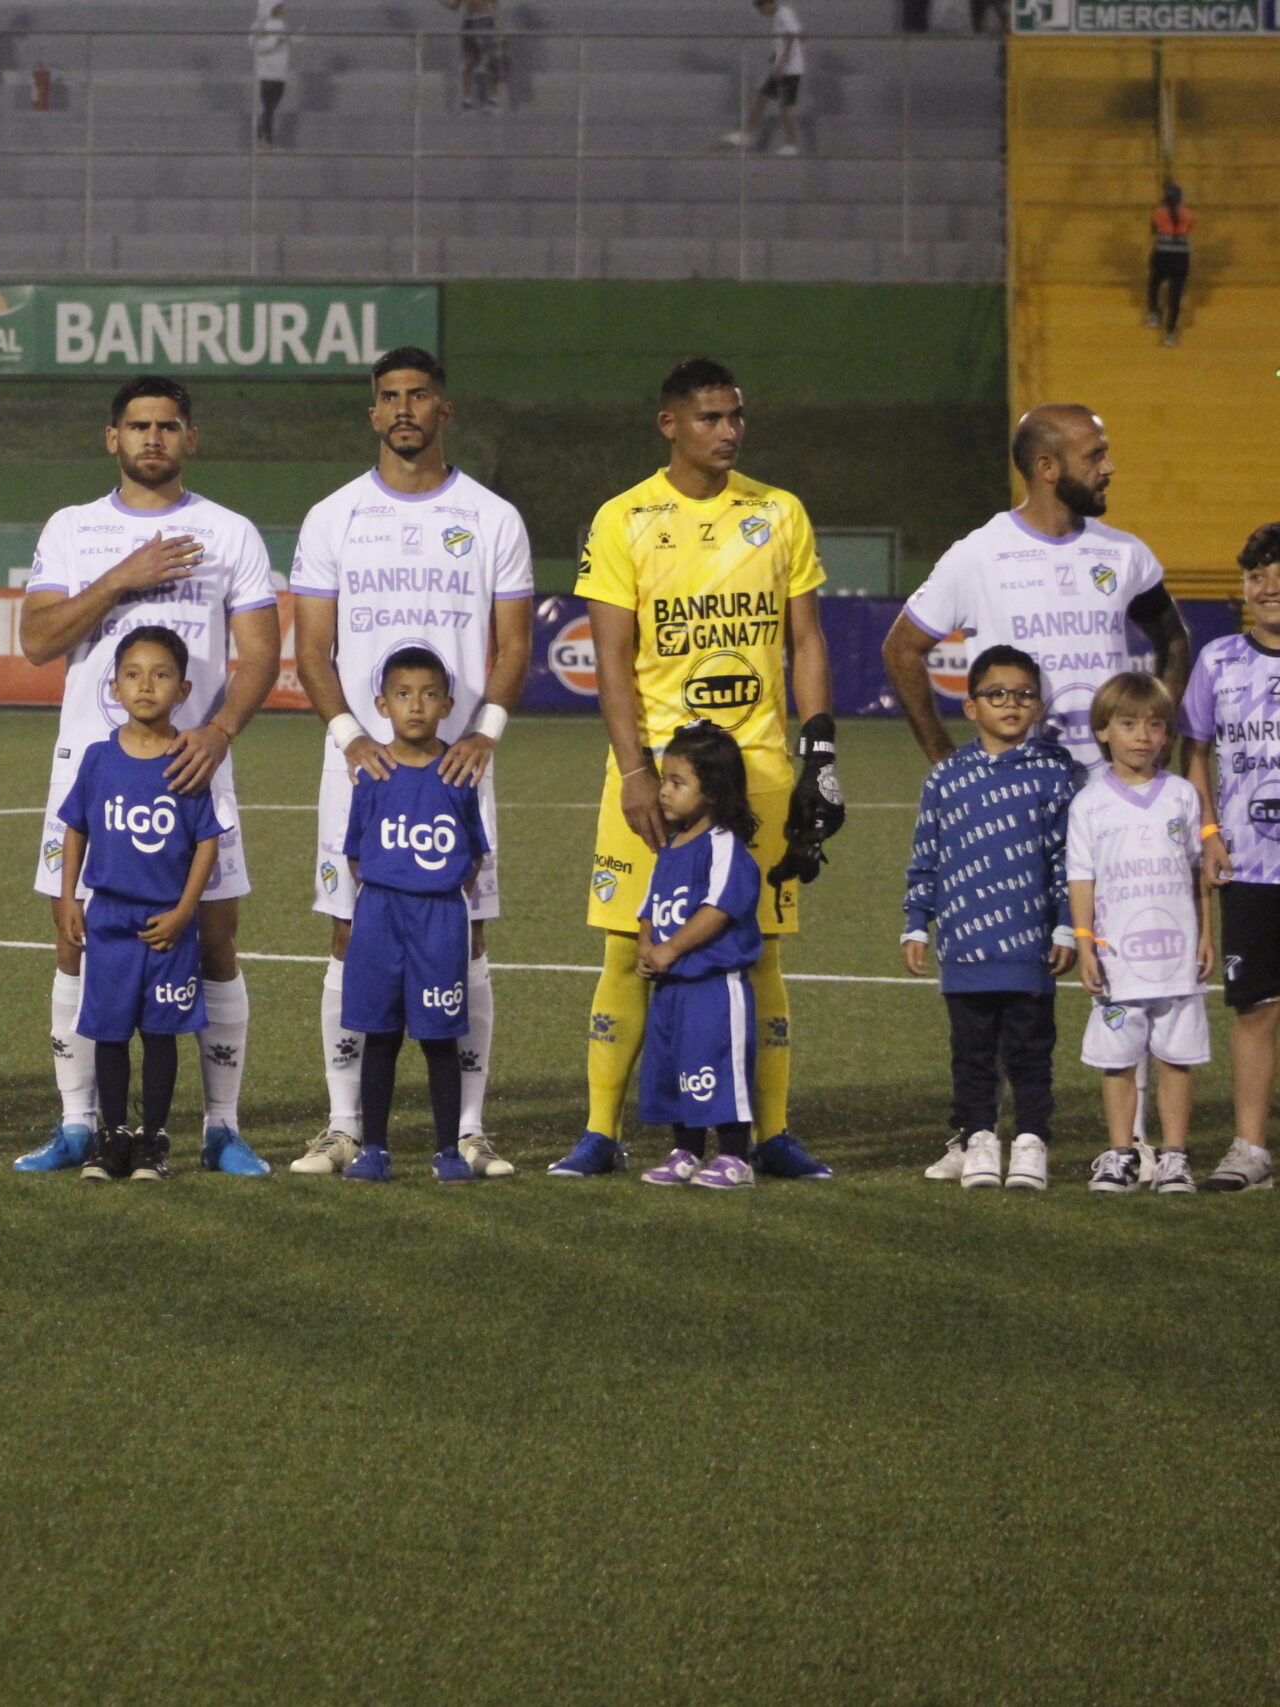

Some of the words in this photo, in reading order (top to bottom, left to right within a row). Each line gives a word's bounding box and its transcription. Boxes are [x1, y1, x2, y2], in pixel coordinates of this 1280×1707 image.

[1077, 5, 1256, 30] EMERGENCIA
[56, 303, 388, 365] BANRURAL
[349, 535, 392, 544] KELME
[404, 526, 419, 545] Z
[699, 523, 715, 543] Z
[80, 547, 122, 555] KELME
[346, 567, 475, 596] BANRURAL
[1000, 579, 1046, 590] KELME
[1056, 566, 1073, 587] Z
[375, 609, 473, 629] GANA777
[654, 591, 779, 623] BANRURAL
[692, 620, 779, 650] GANA777
[685, 680, 759, 705] Gulf
[105, 795, 176, 835] tigo
[381, 814, 456, 854] tigo
[1125, 933, 1184, 957] Gulf
[155, 976, 198, 1004] tigo
[423, 981, 463, 1007] tigo
